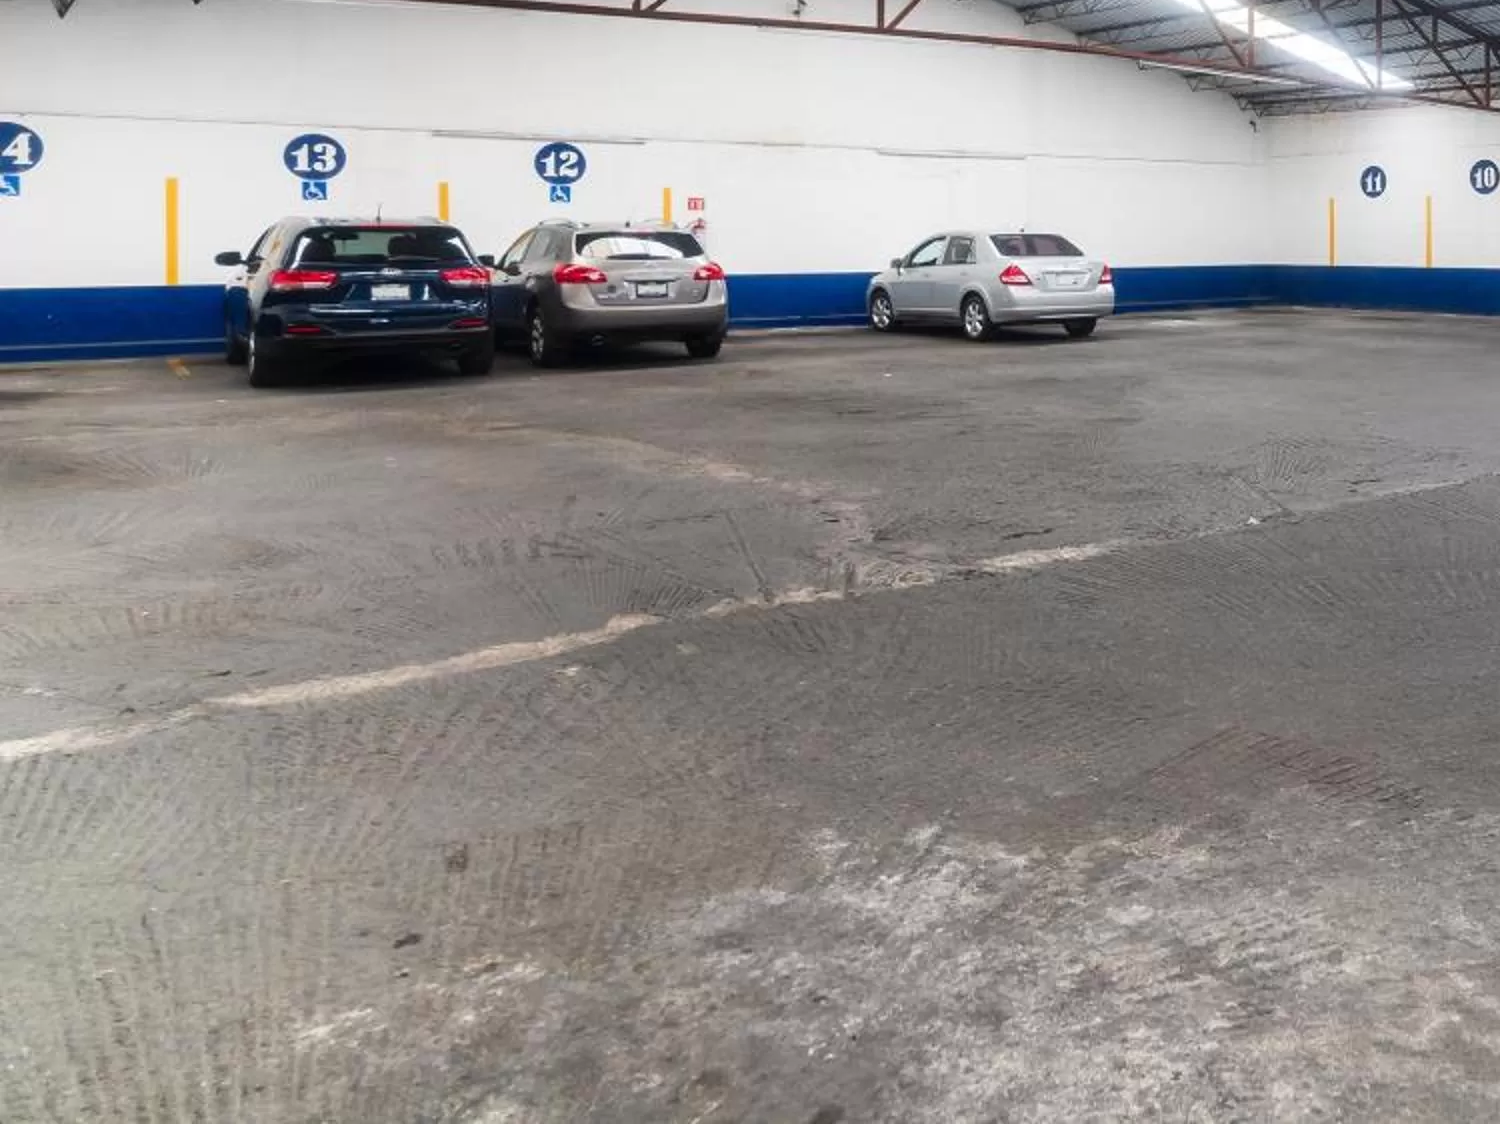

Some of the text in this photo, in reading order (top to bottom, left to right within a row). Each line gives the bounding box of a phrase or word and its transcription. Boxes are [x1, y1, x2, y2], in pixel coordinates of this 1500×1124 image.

[2, 133, 33, 164] 4
[291, 144, 337, 172] 13
[540, 151, 579, 177] 12
[1365, 173, 1383, 193] 11
[1474, 166, 1496, 189] 10
